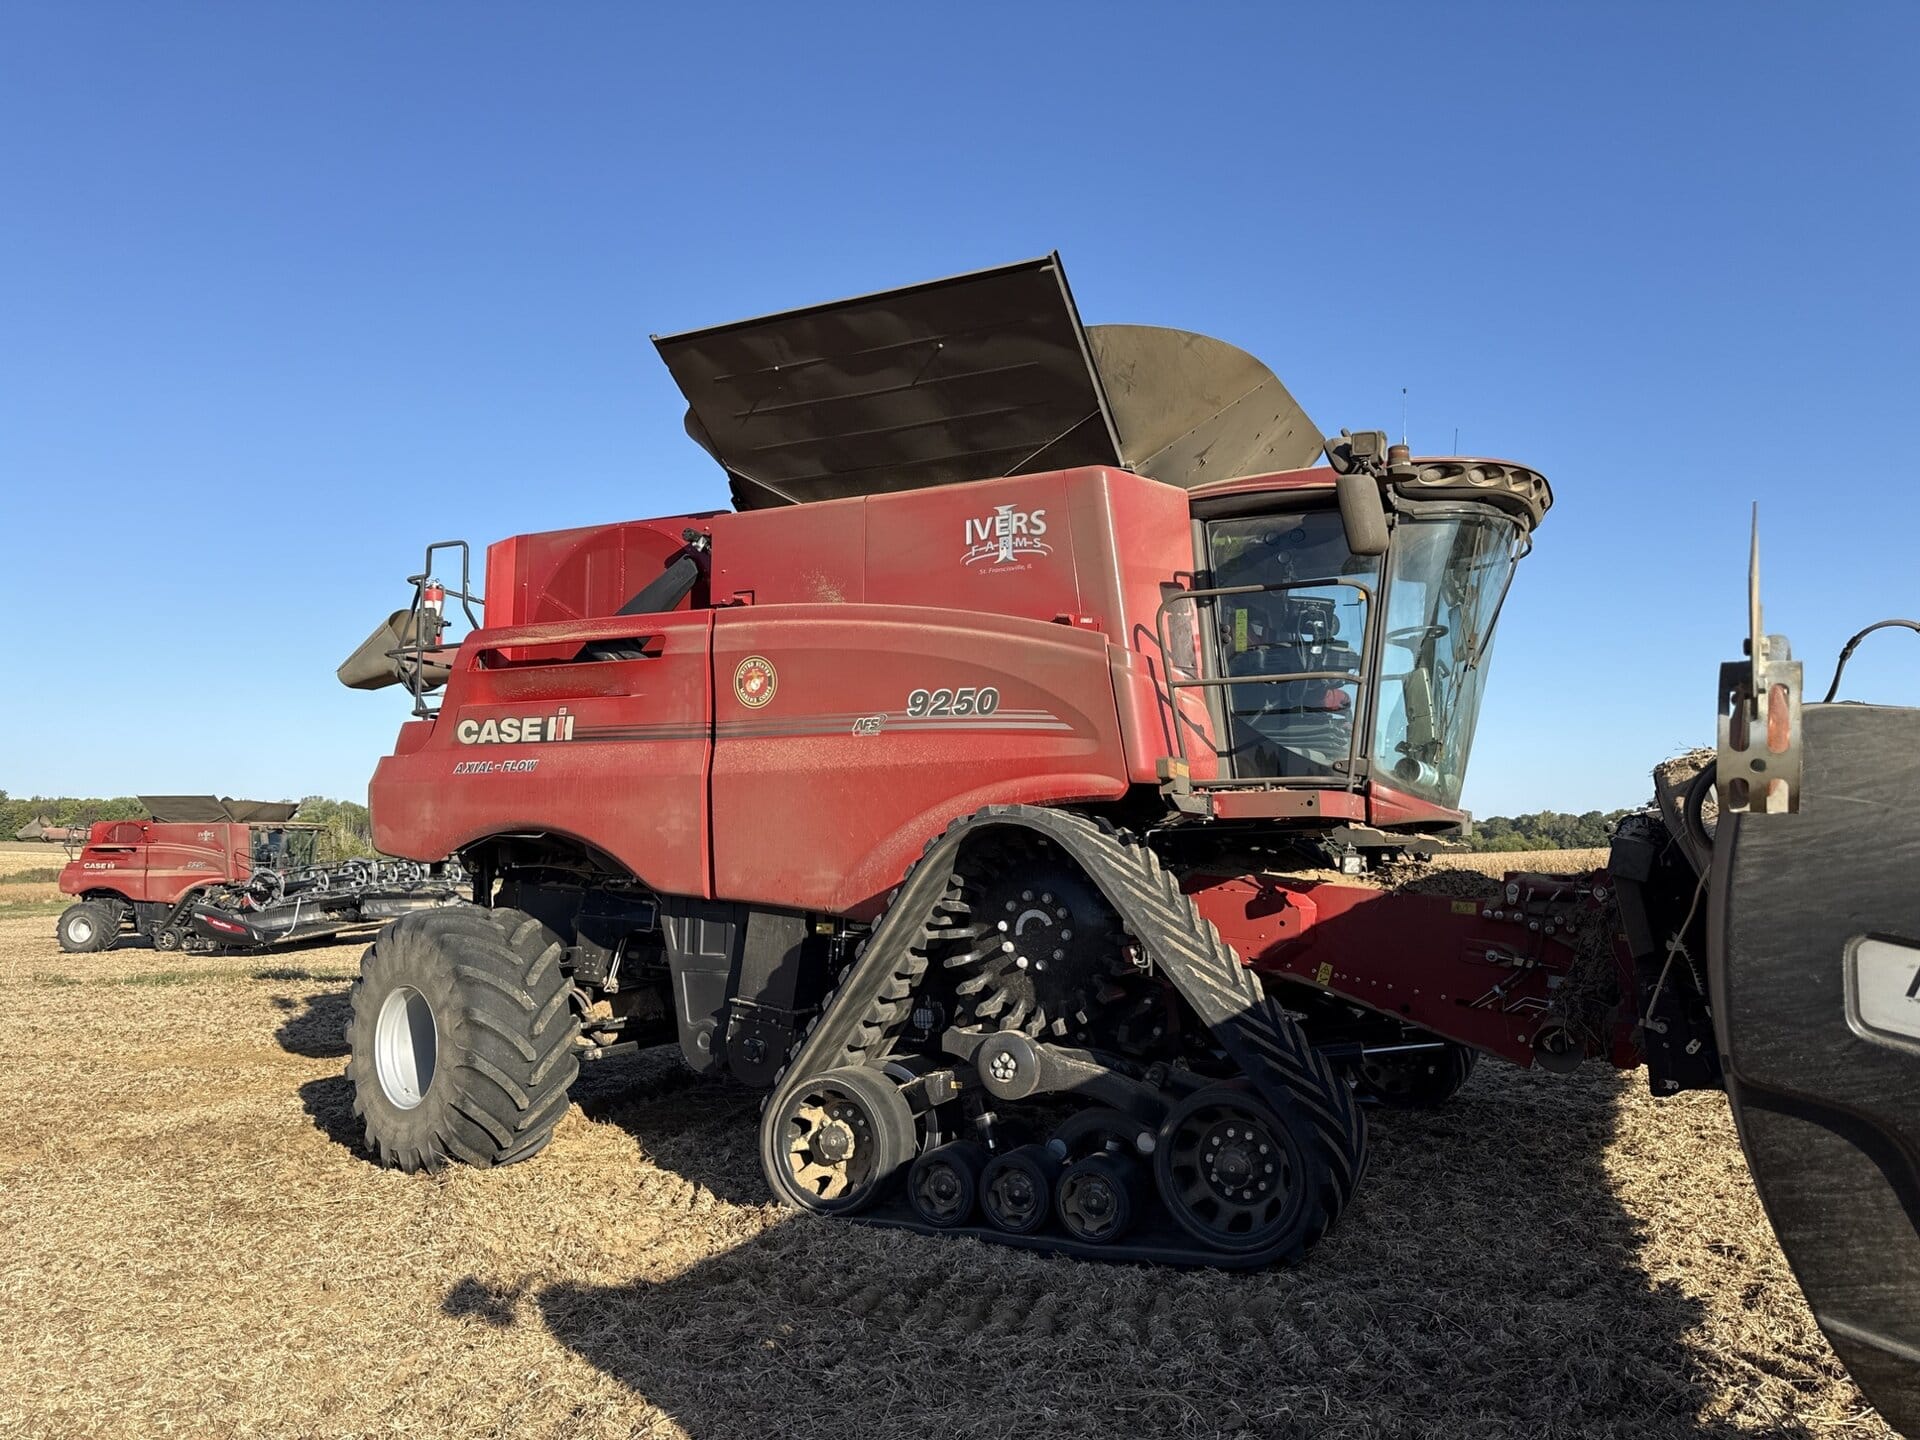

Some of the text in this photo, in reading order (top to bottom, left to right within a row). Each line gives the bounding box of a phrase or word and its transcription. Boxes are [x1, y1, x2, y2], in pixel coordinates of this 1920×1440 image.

[965, 509, 1047, 545] IVERS
[971, 537, 1041, 557] FARMS
[738, 660, 771, 679] UNITED STATES
[739, 686, 772, 703] MARINE CORPS
[906, 687, 1000, 718] 9250
[457, 718, 543, 745] CASE
[853, 718, 880, 731] AFS
